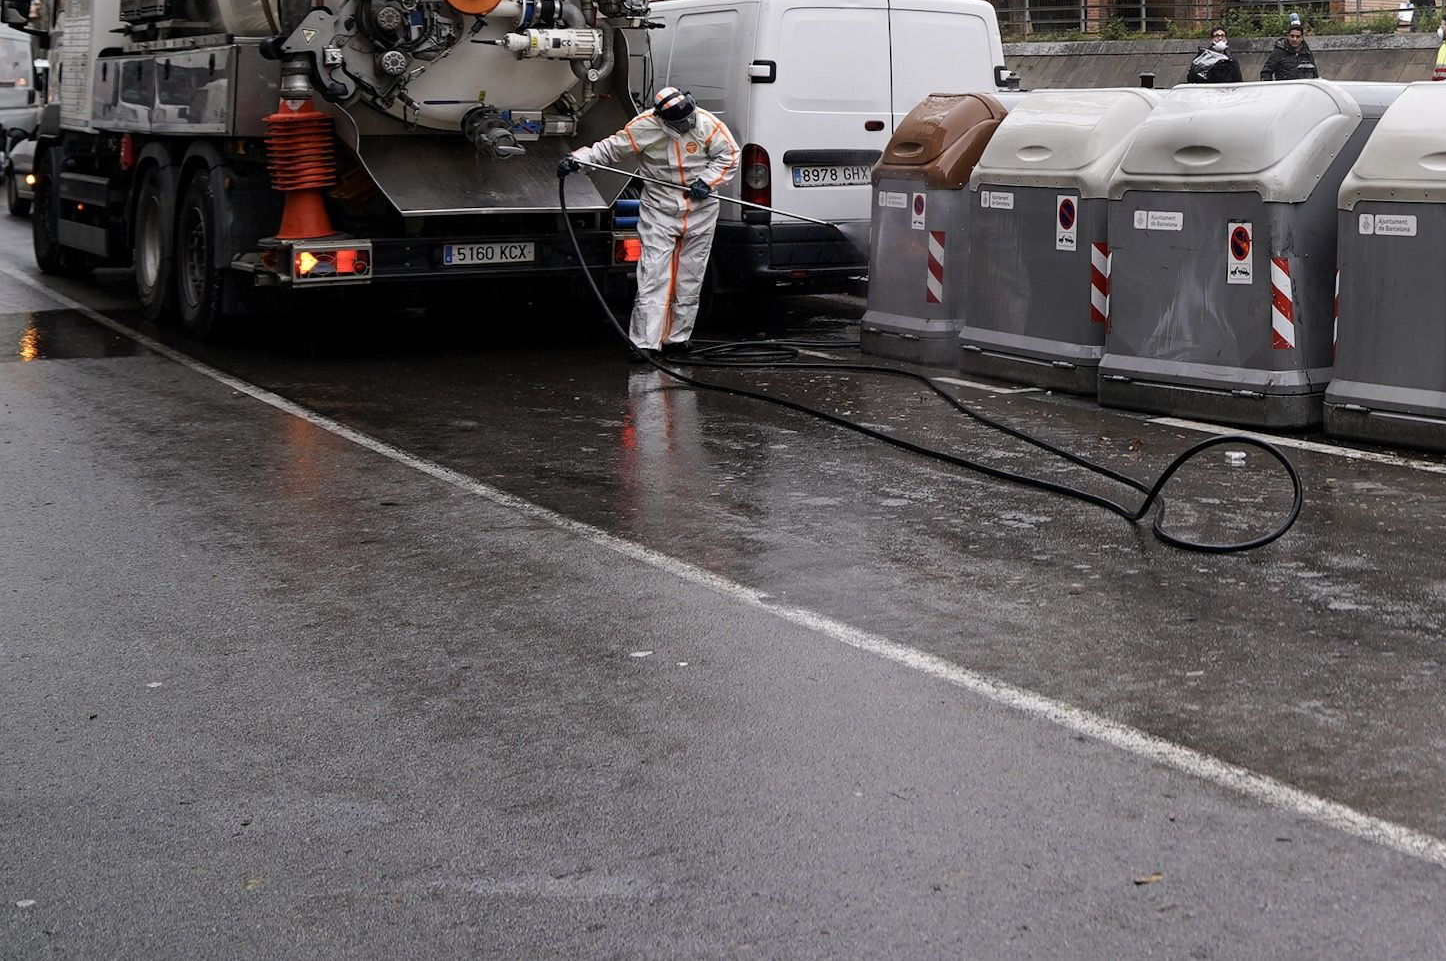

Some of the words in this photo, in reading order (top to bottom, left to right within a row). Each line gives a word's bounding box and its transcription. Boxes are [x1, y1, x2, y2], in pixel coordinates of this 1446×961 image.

[802, 168, 838, 182] 8978
[843, 167, 869, 180] GHX
[457, 246, 494, 261] 5160
[500, 245, 527, 260] KCX
